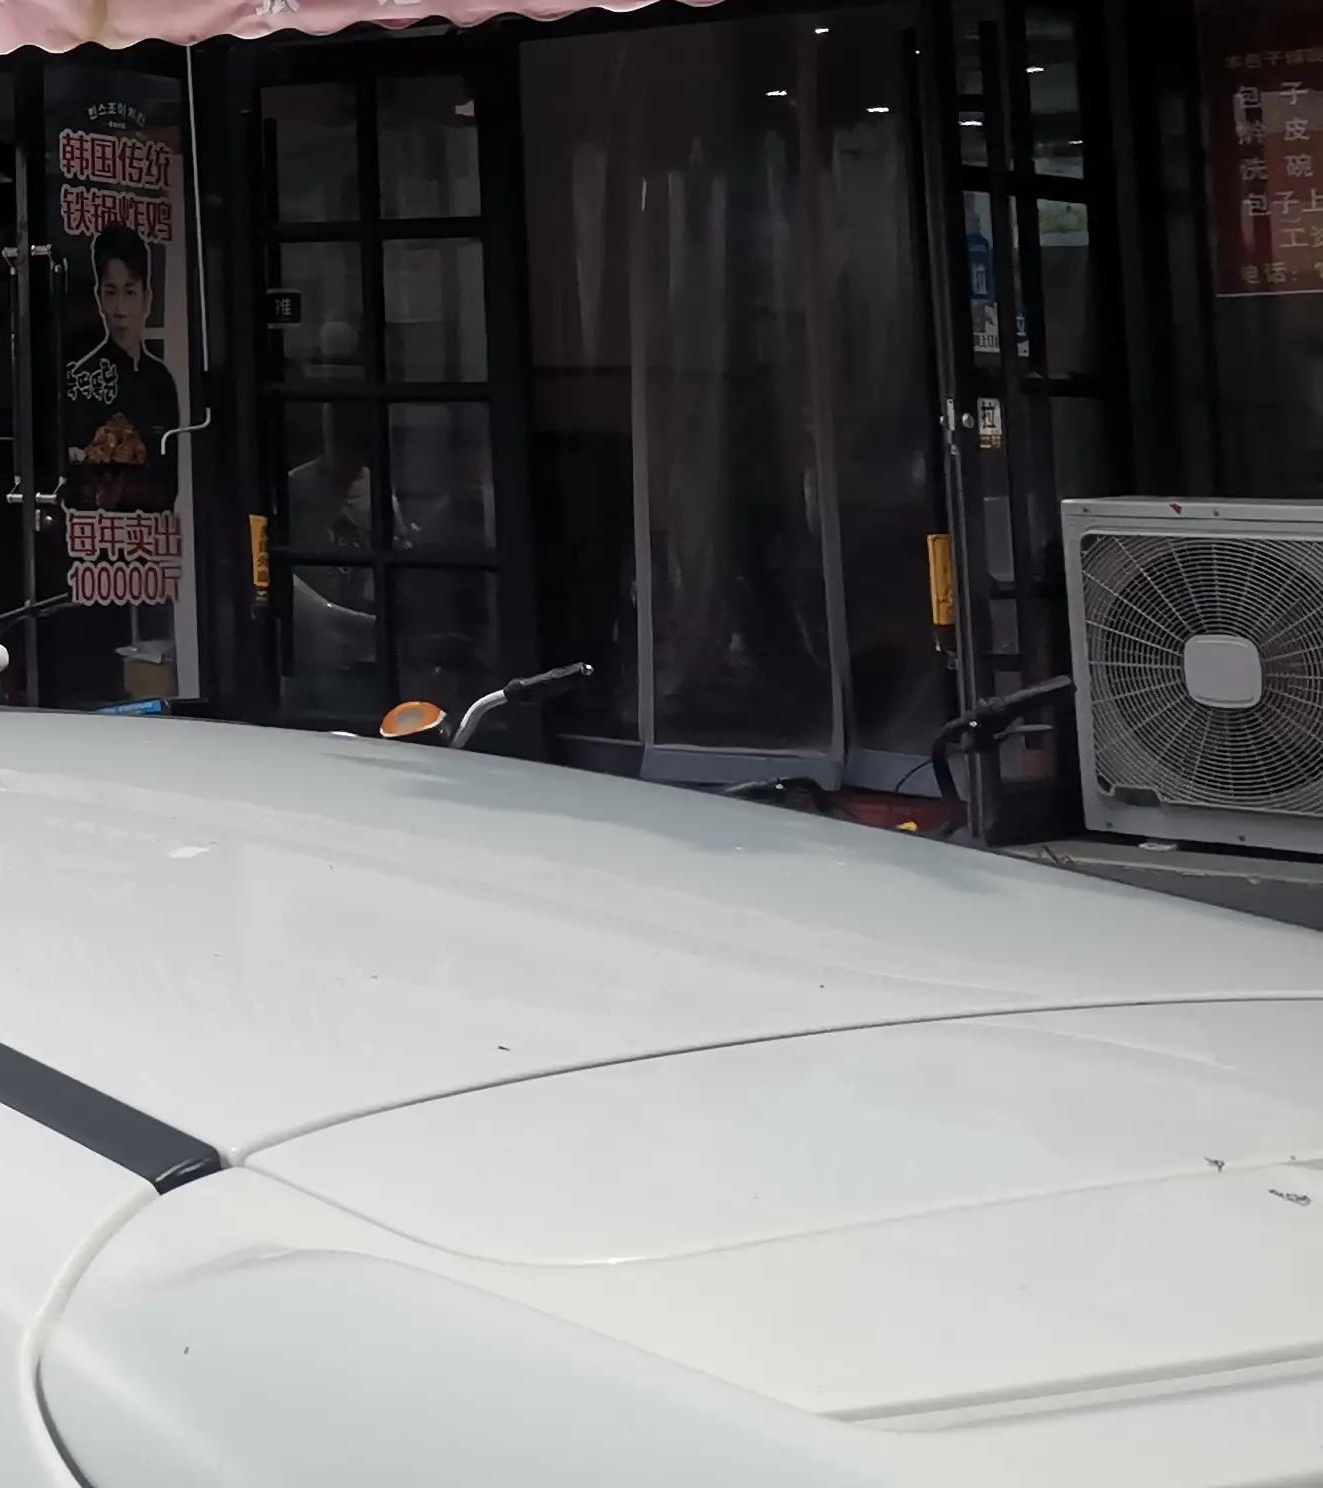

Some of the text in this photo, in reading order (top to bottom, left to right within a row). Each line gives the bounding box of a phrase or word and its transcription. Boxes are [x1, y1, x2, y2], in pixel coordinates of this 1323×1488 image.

[60, 130, 173, 190] 韩国传统
[69, 513, 182, 556] 每年卖出
